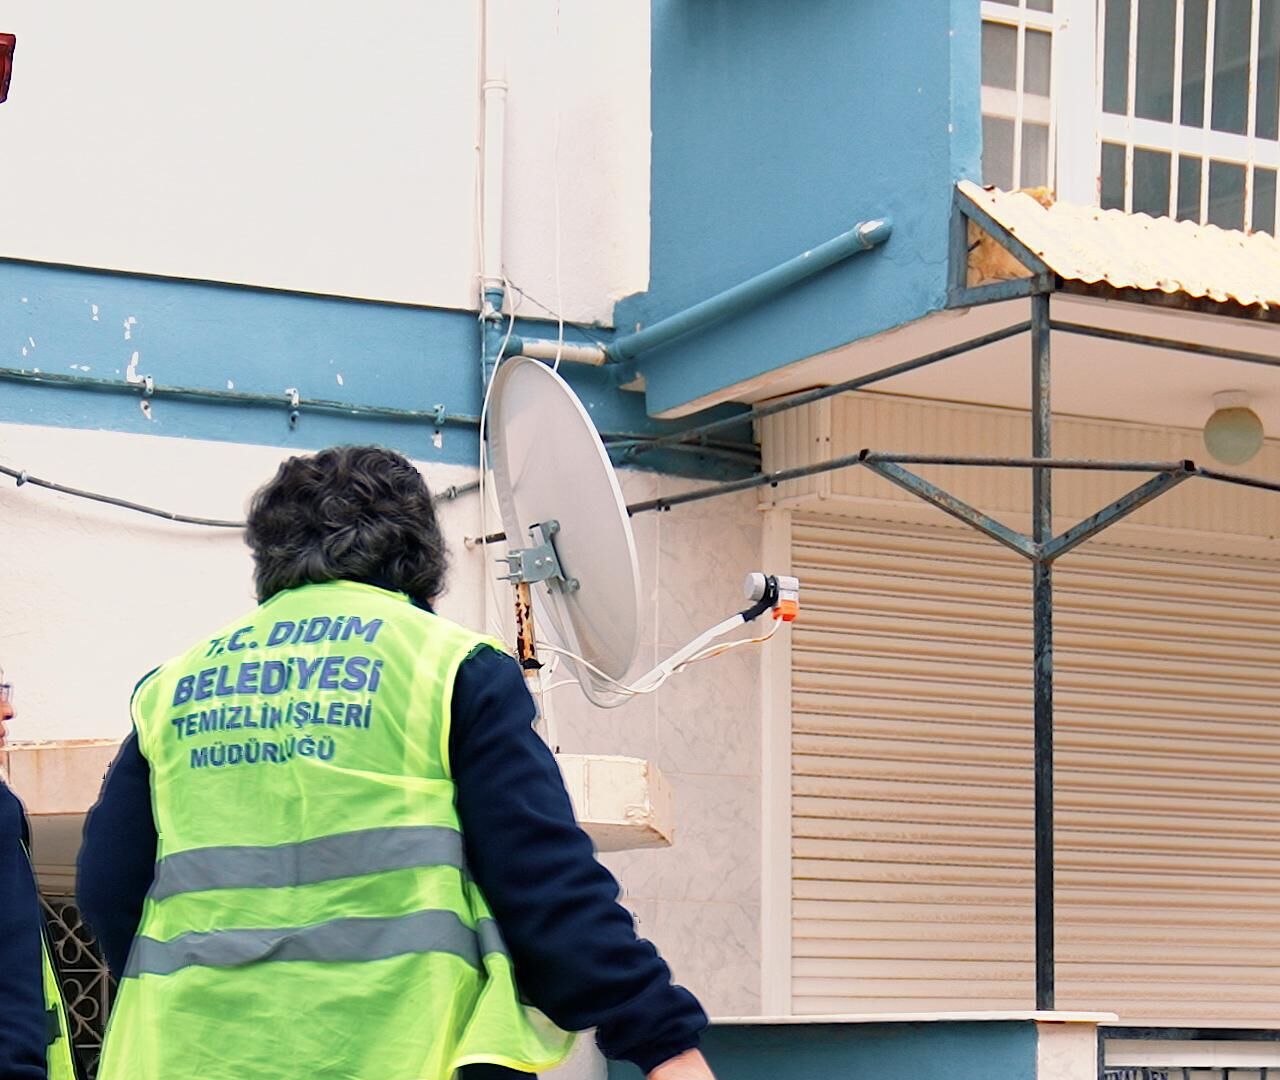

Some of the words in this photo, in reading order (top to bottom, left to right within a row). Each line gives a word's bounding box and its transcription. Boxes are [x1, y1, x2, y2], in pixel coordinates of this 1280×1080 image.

[266, 616, 383, 647] DİDİM
[172, 656, 383, 707] BELEDİYESİ
[285, 697, 372, 729] İŞLERİ
